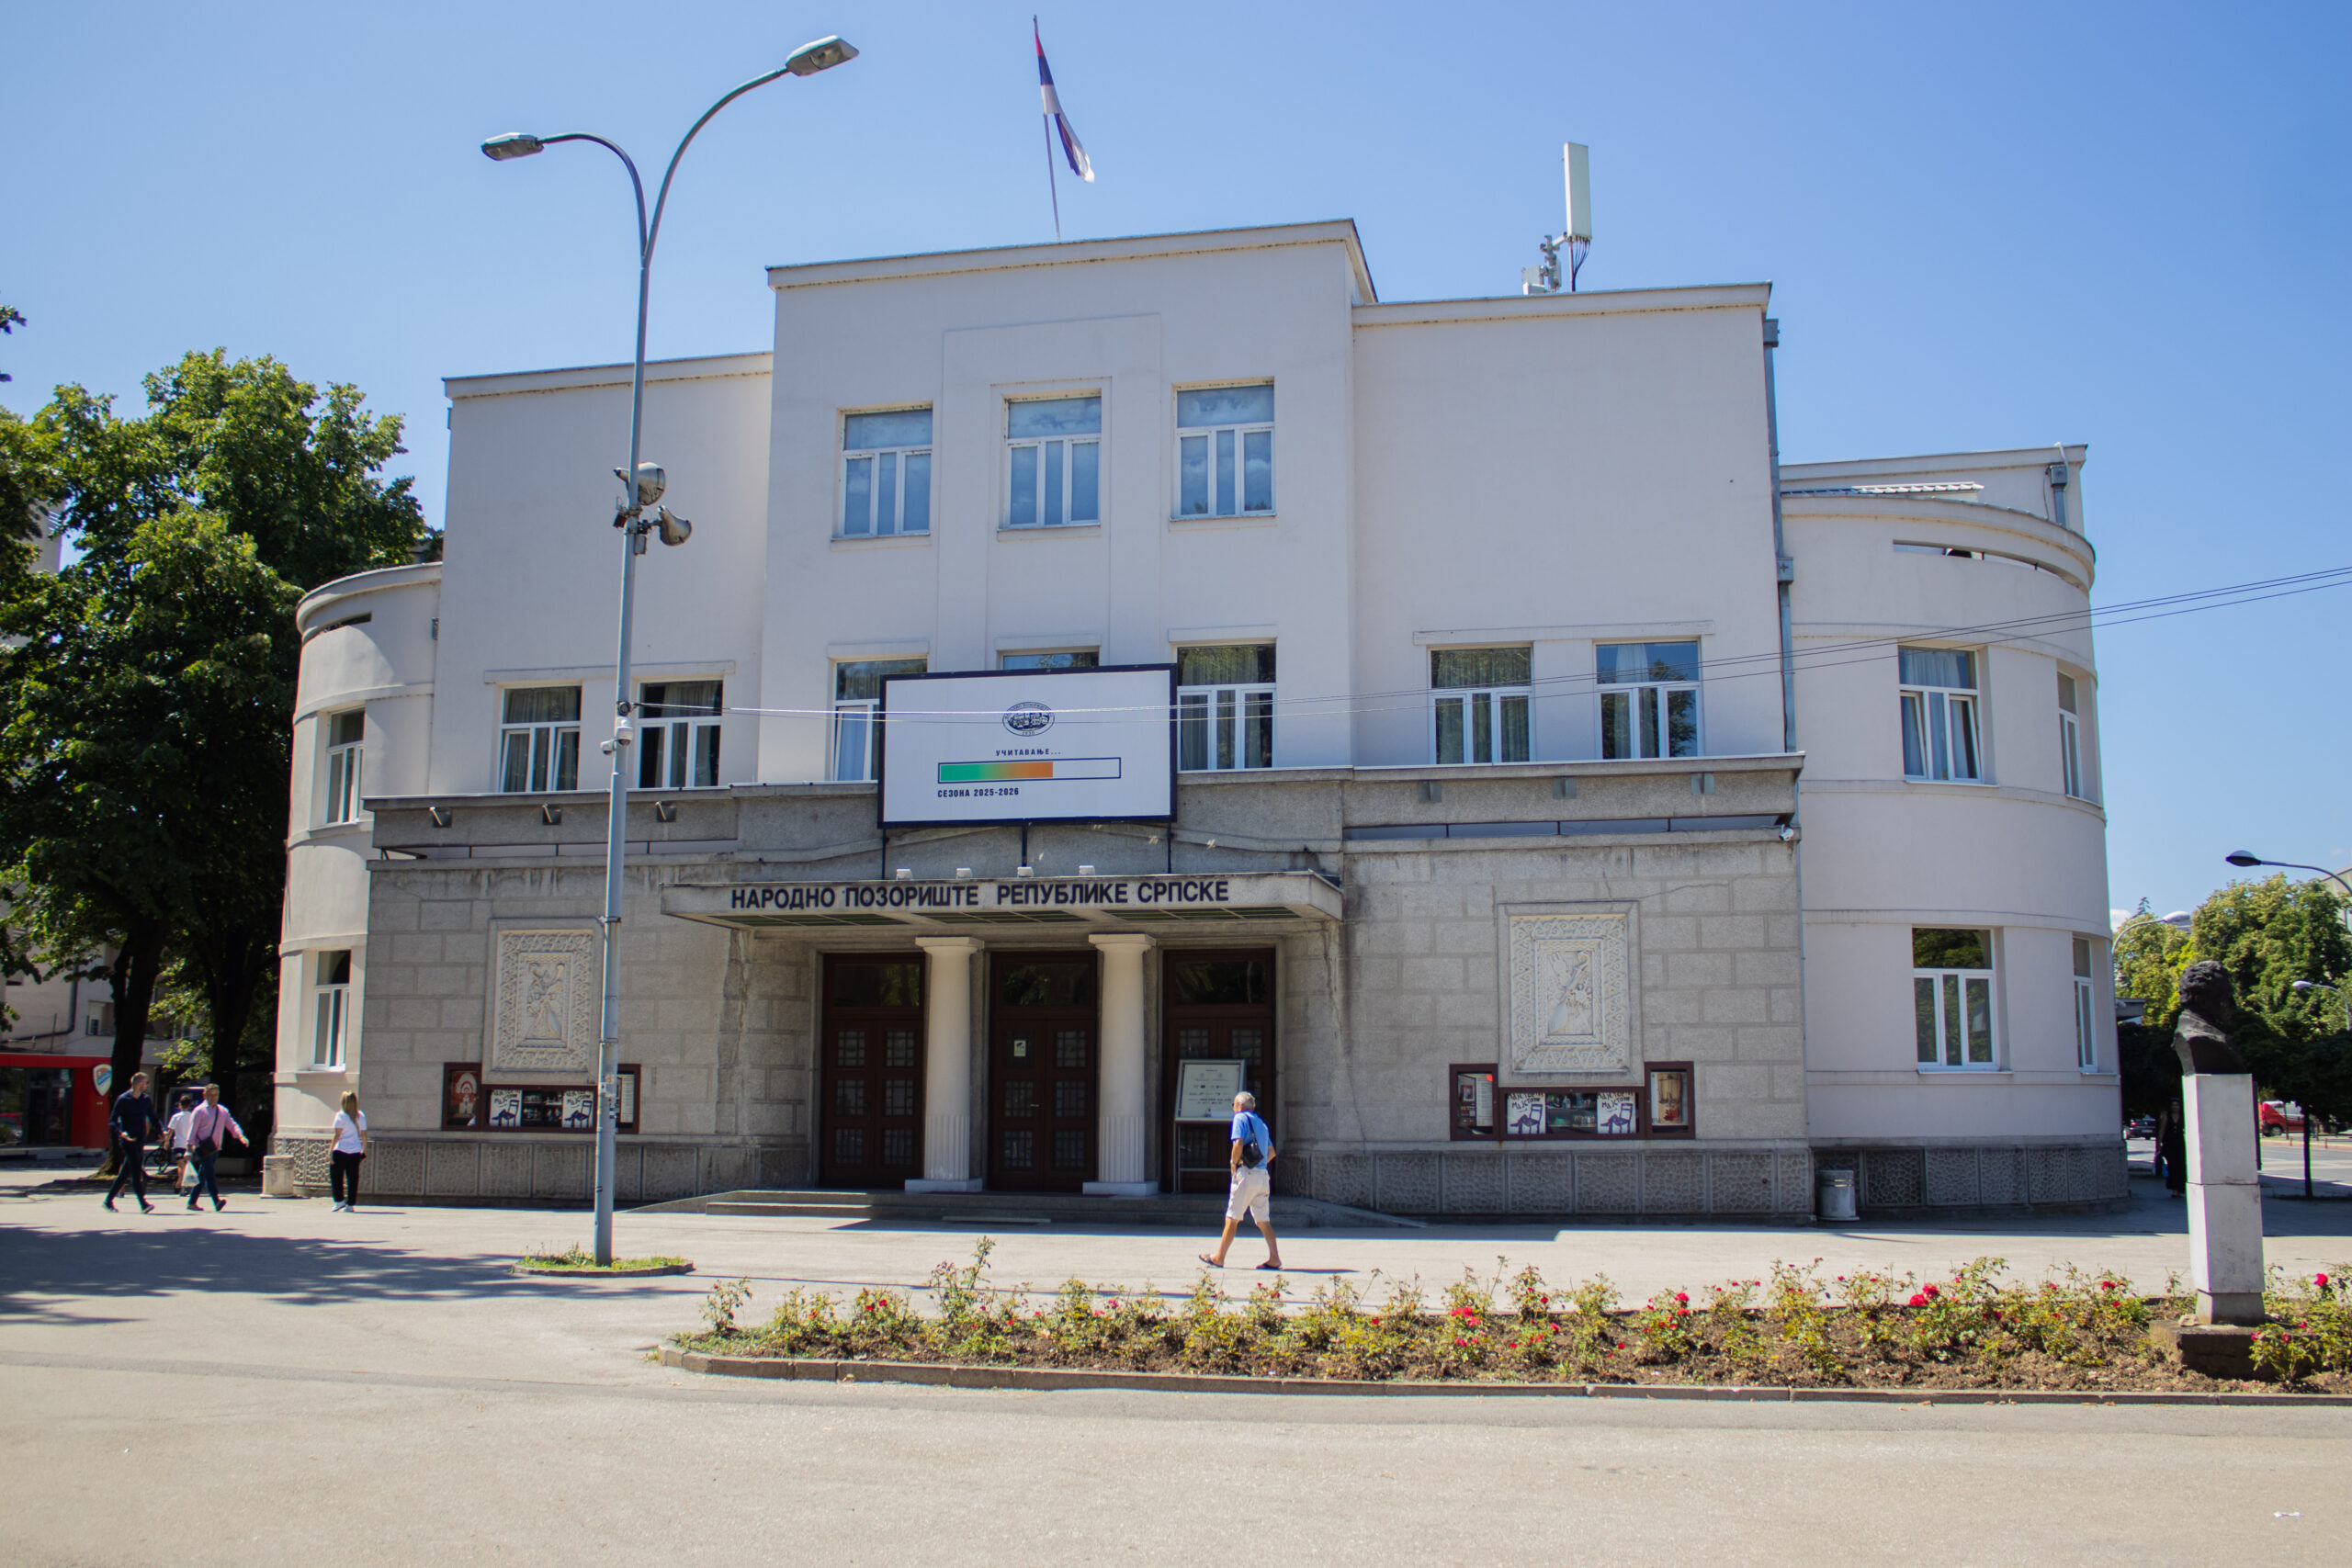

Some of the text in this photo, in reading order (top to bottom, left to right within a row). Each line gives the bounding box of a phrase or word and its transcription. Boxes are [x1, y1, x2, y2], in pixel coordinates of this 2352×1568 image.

[995, 748, 1061, 757] УЧИТАВАЊЕ...
[937, 787, 1019, 798] СЕЗОНА 2025-2026
[731, 881, 1229, 909] НАРОДНО ПОЗОРИШТЕ РЕПУБЛИКЕ СРПСКЕ
